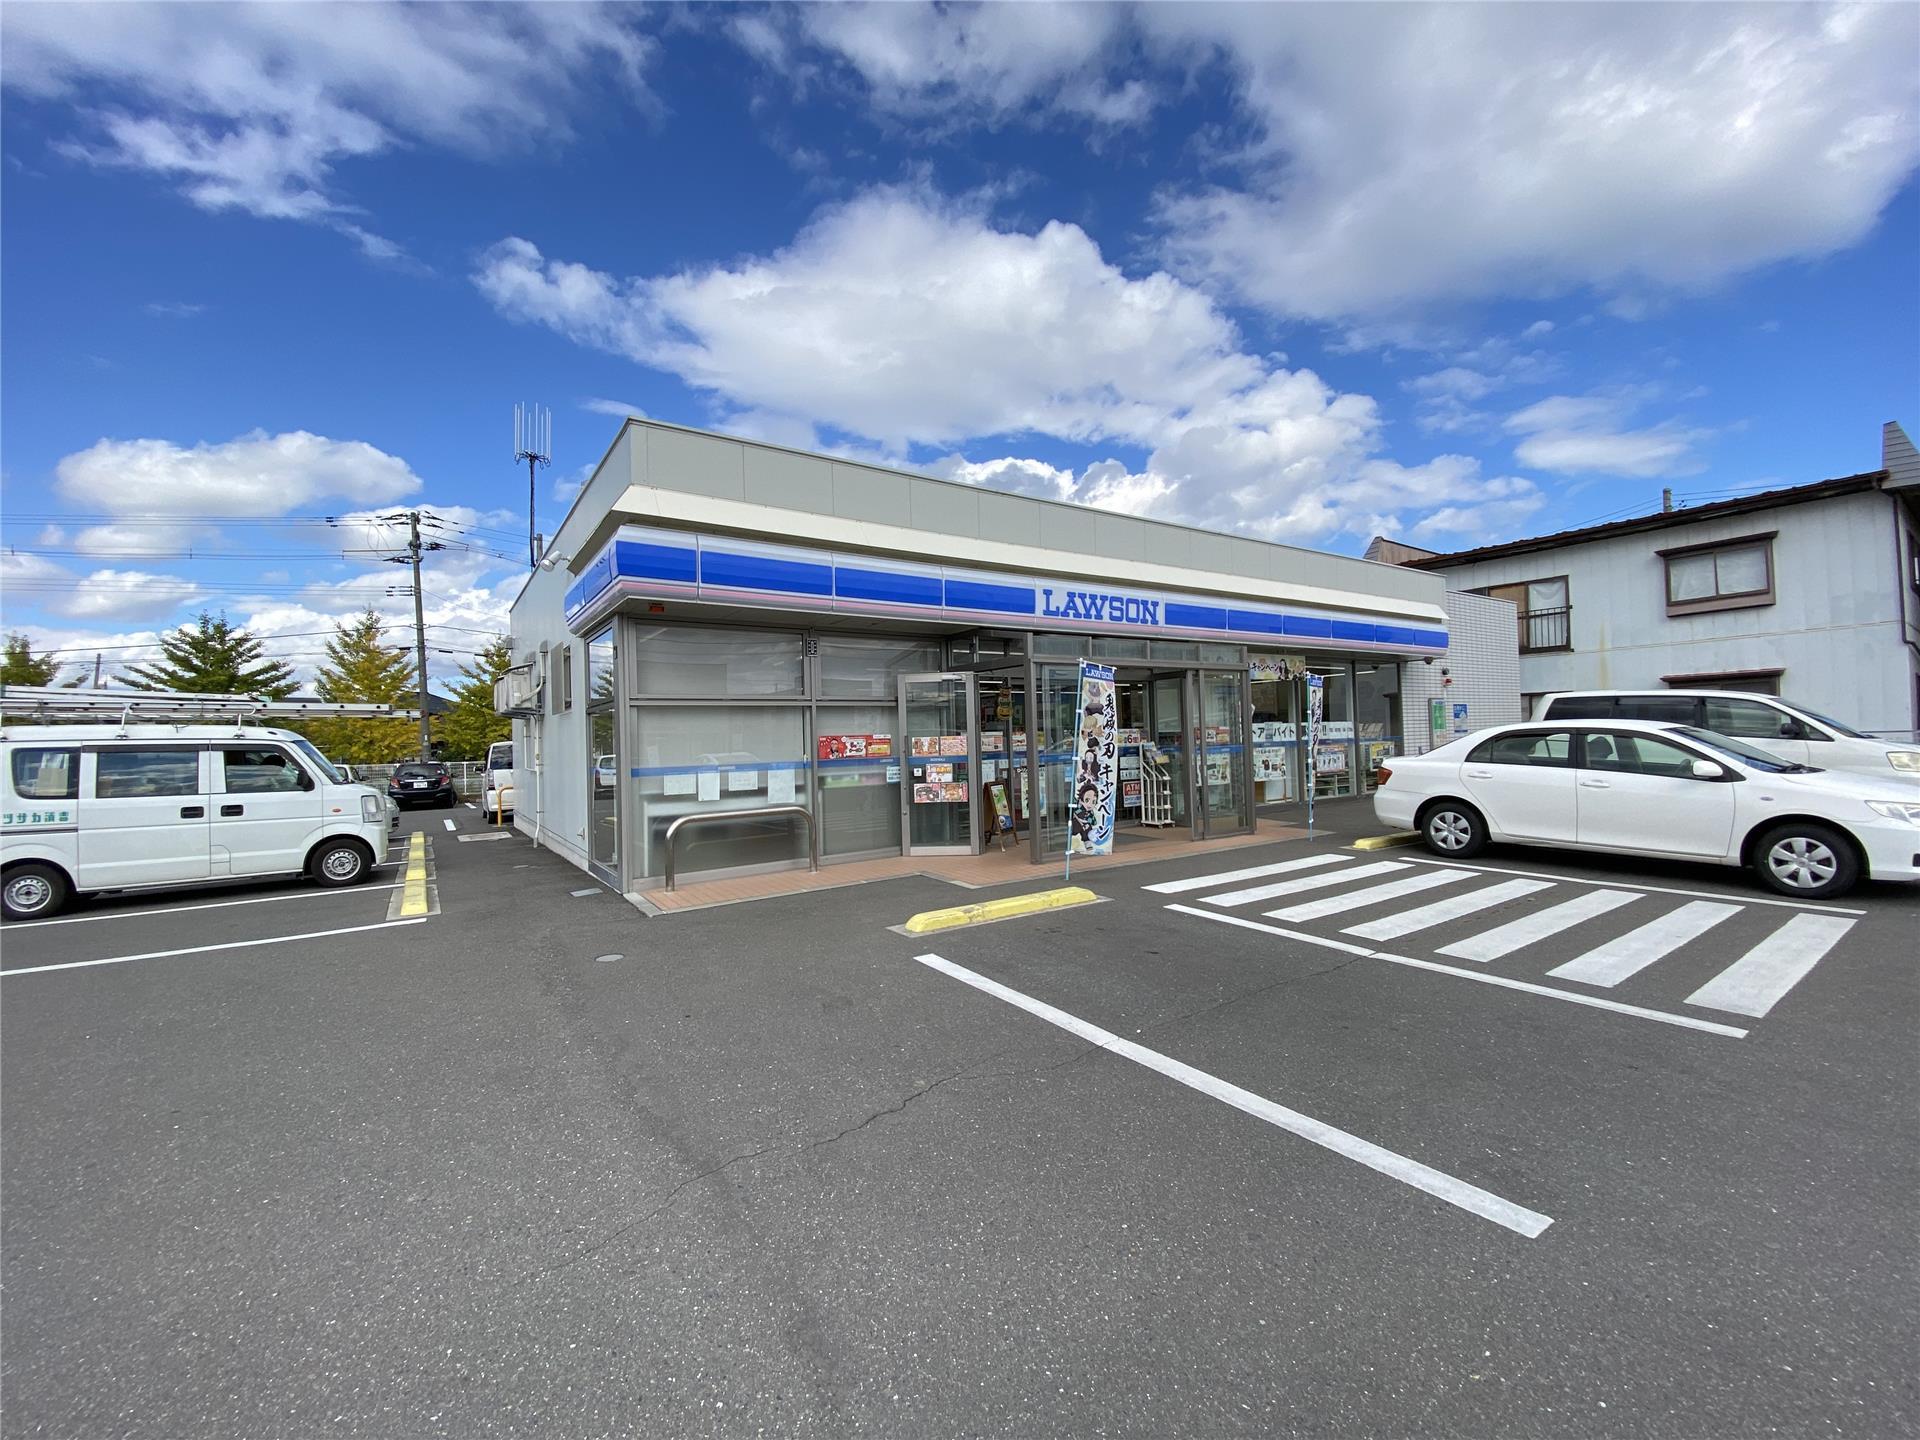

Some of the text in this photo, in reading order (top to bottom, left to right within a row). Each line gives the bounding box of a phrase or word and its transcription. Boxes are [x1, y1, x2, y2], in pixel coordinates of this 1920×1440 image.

[1042, 589, 1160, 626] LAWSON
[1085, 668, 1114, 680] LAWSON
[1252, 725, 1295, 738] アバイト
[1098, 692, 1116, 840] 鬼滅の刃 キャンペーン
[1126, 784, 1140, 793] ATM
